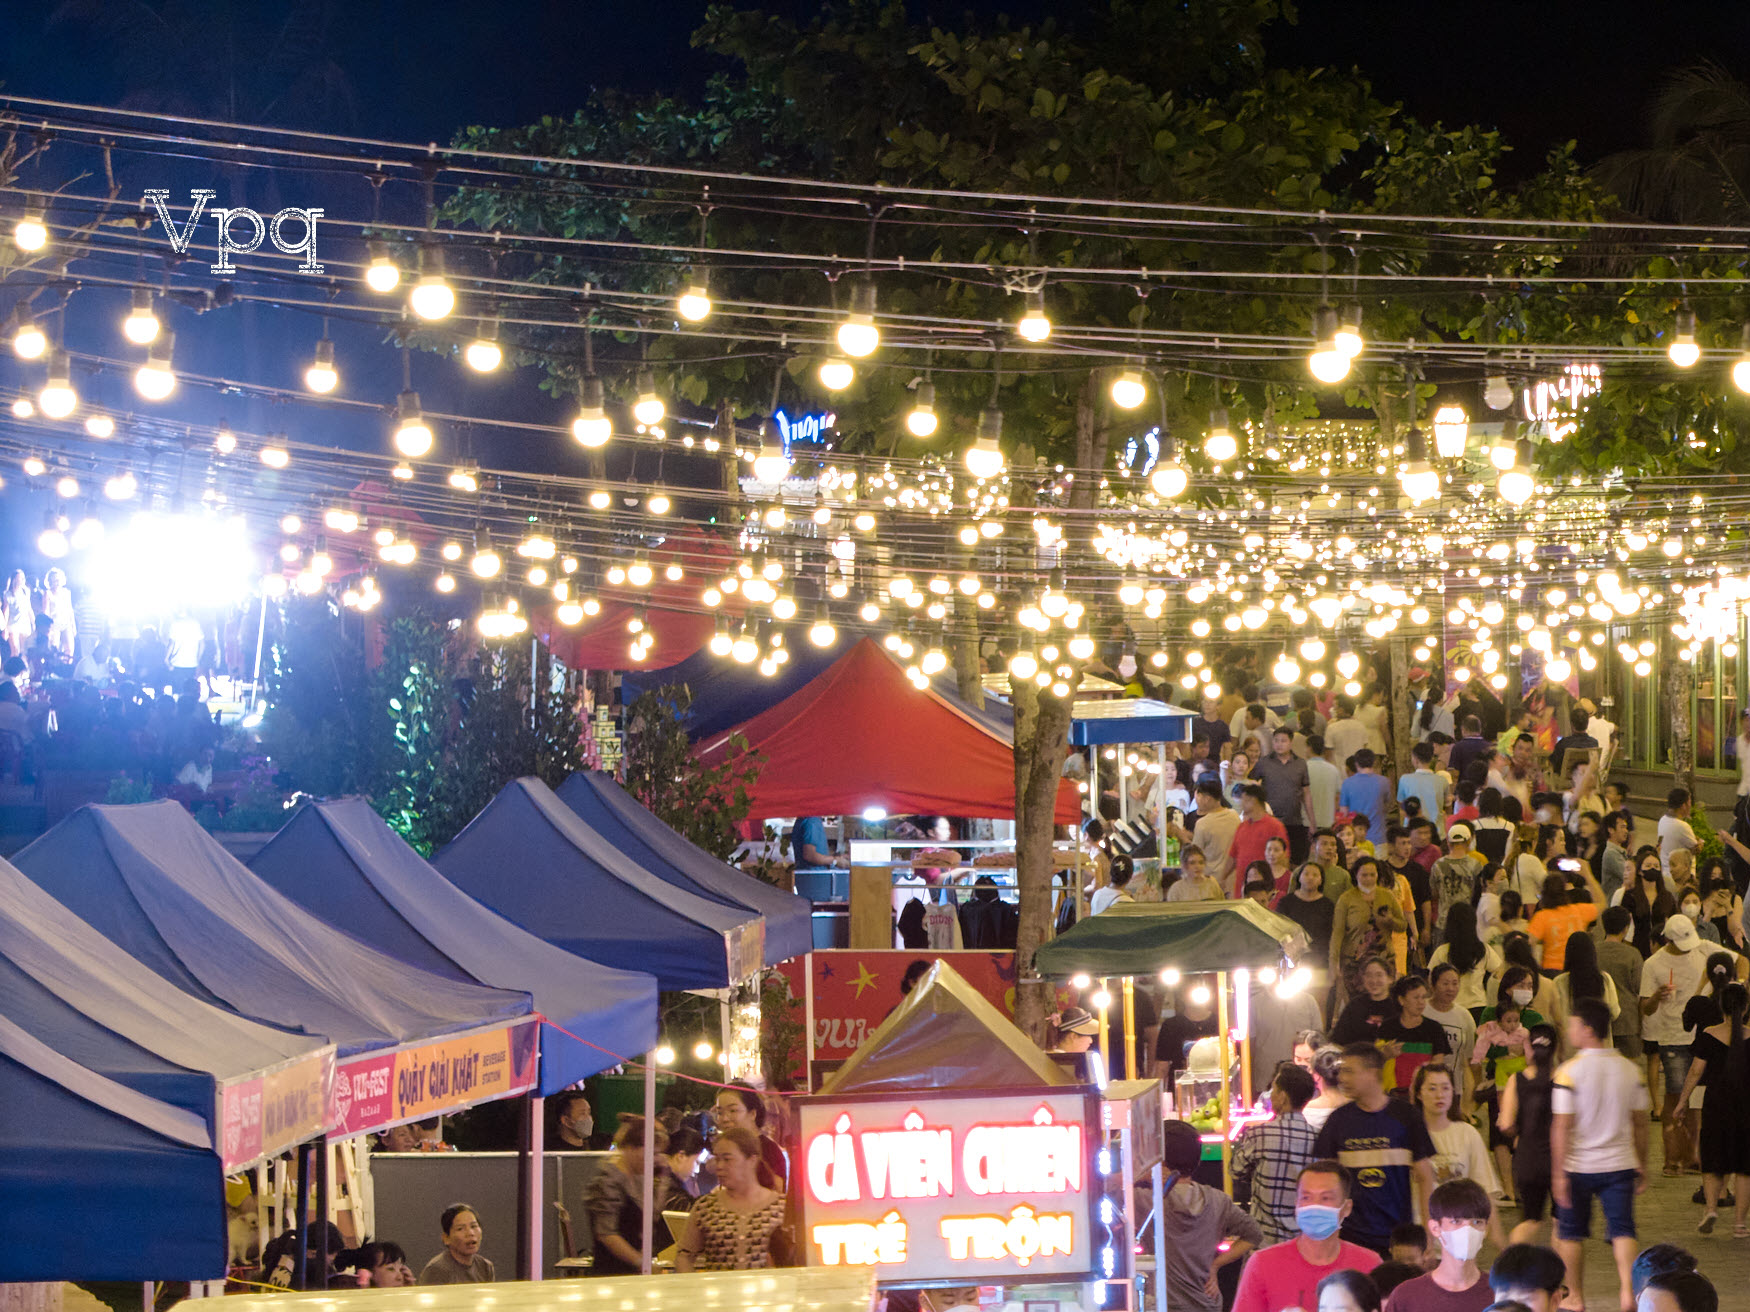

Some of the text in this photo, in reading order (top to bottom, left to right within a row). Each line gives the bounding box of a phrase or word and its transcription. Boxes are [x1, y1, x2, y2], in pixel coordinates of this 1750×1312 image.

[452, 1049, 480, 1096] KHÁT
[807, 1112, 861, 1204] CÁ
[812, 1202, 1073, 1268] TRÉ TRỘN
